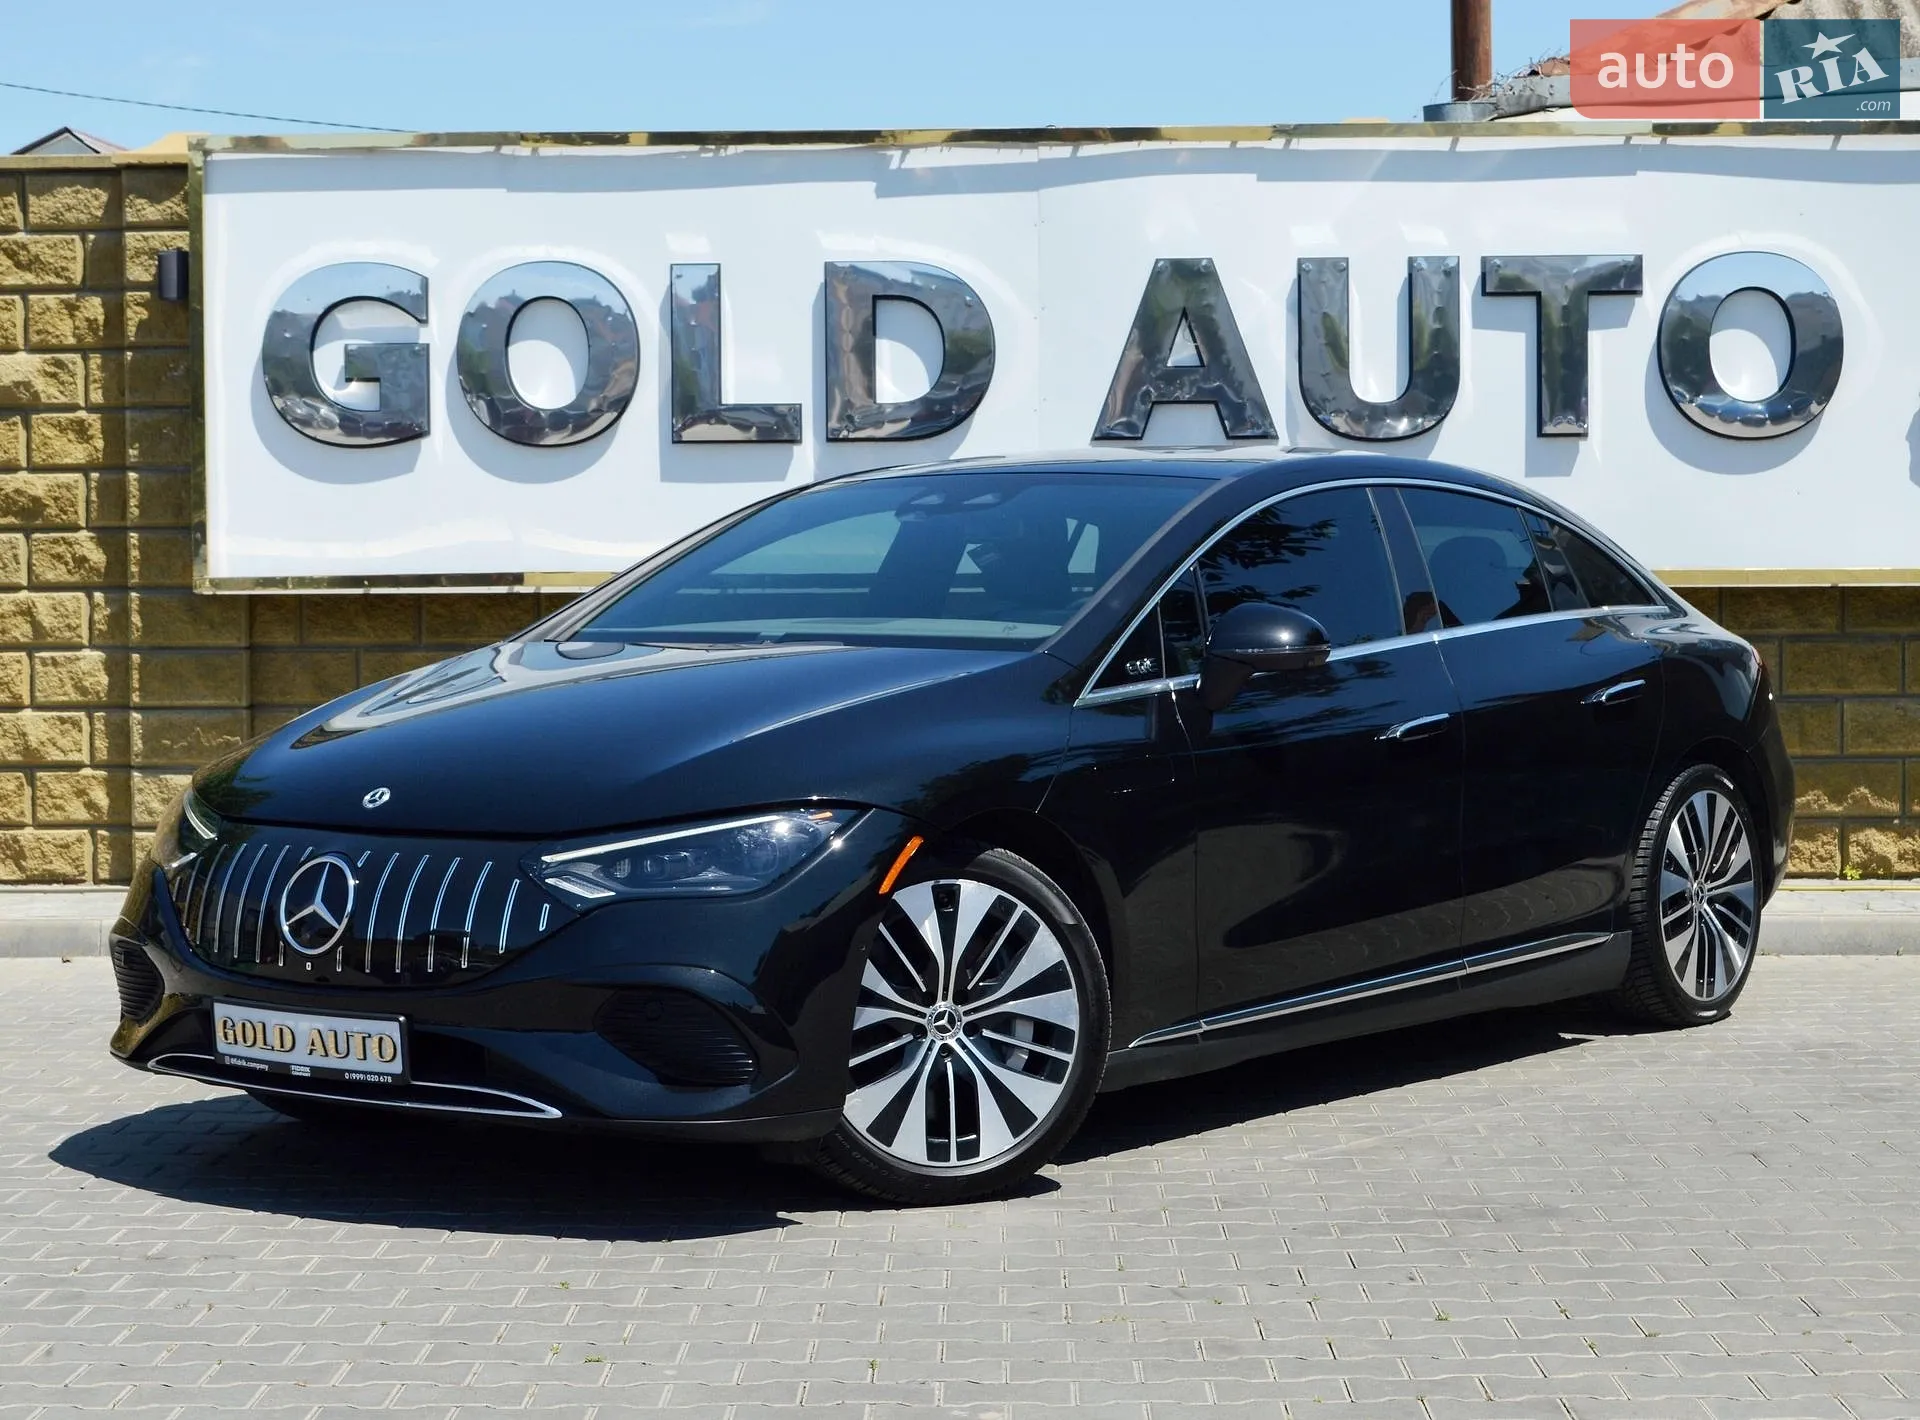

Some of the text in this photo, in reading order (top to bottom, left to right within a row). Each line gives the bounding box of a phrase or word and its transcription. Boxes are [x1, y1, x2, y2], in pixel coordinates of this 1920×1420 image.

[262, 251, 1845, 449] GOLD AUTO
[217, 1016, 398, 1063] GOLD AUTO
[366, 1074, 379, 1082] 020
